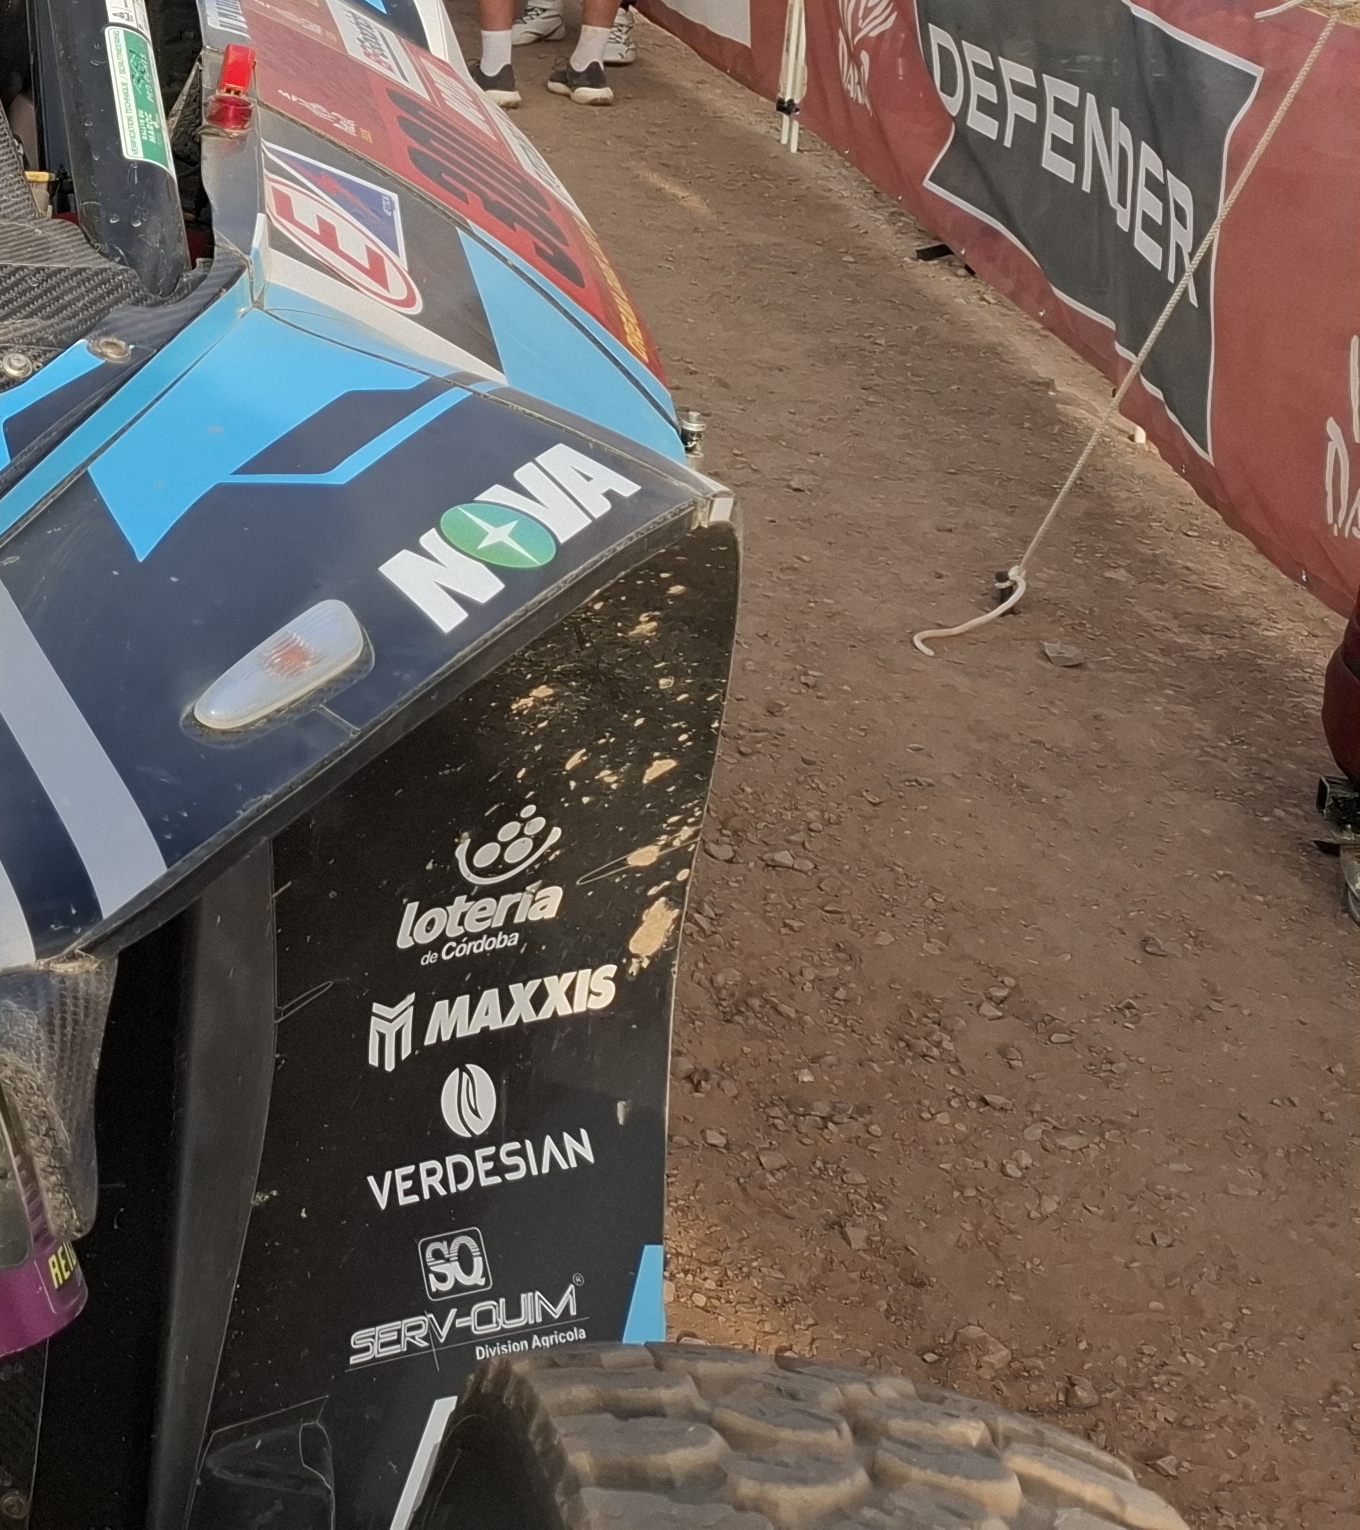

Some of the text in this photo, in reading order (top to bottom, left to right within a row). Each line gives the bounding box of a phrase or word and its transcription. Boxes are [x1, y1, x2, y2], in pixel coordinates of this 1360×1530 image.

[928, 22, 1199, 308] DEFENDER
[379, 443, 641, 633] NOVA
[421, 931, 519, 966] de Córdoba
[424, 964, 618, 1046] MAXXIS
[367, 1127, 595, 1210] VERDESIAN
[425, 1240, 486, 1292] SQ
[350, 1284, 577, 1365] SERV-QUIM
[475, 1326, 587, 1361] Division Agricola
